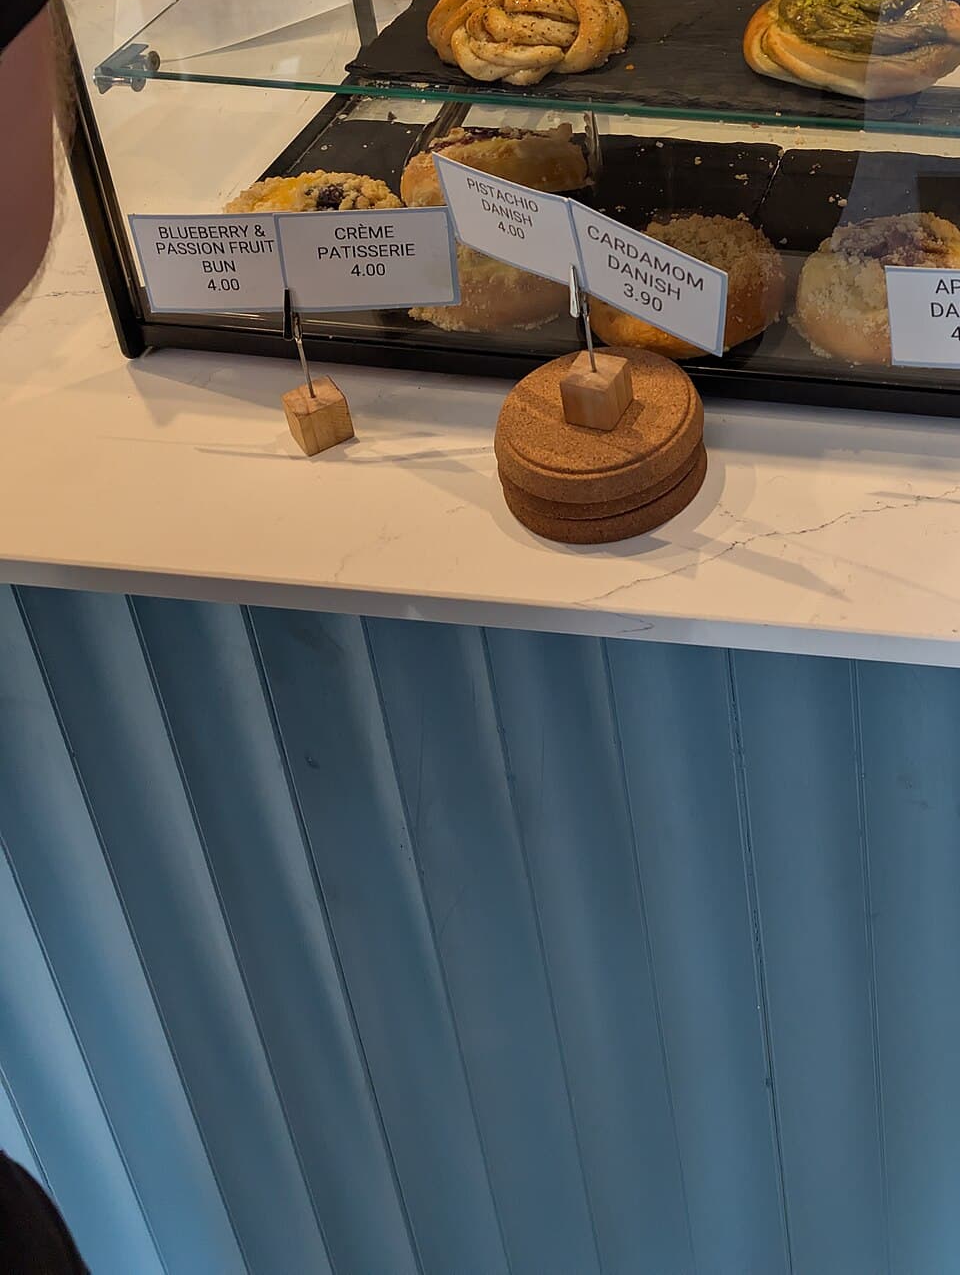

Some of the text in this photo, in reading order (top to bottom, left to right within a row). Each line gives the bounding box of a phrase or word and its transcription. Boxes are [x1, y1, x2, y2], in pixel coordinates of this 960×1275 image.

[466, 177, 539, 213] PISTACHIO
[481, 198, 533, 227] DANISH
[158, 224, 266, 240] BLUEBERRY &
[334, 223, 395, 241] CRÈME
[497, 221, 525, 239] 4.00
[155, 239, 275, 255] PASSION FRUIT
[317, 243, 416, 260] PATISSERIE
[201, 259, 237, 273] BUN
[586, 225, 706, 291] CARDAMOM
[350, 262, 386, 277] 4.00
[607, 254, 682, 301] DANISH
[206, 277, 241, 292] 4.00
[622, 282, 664, 313] 3.90
